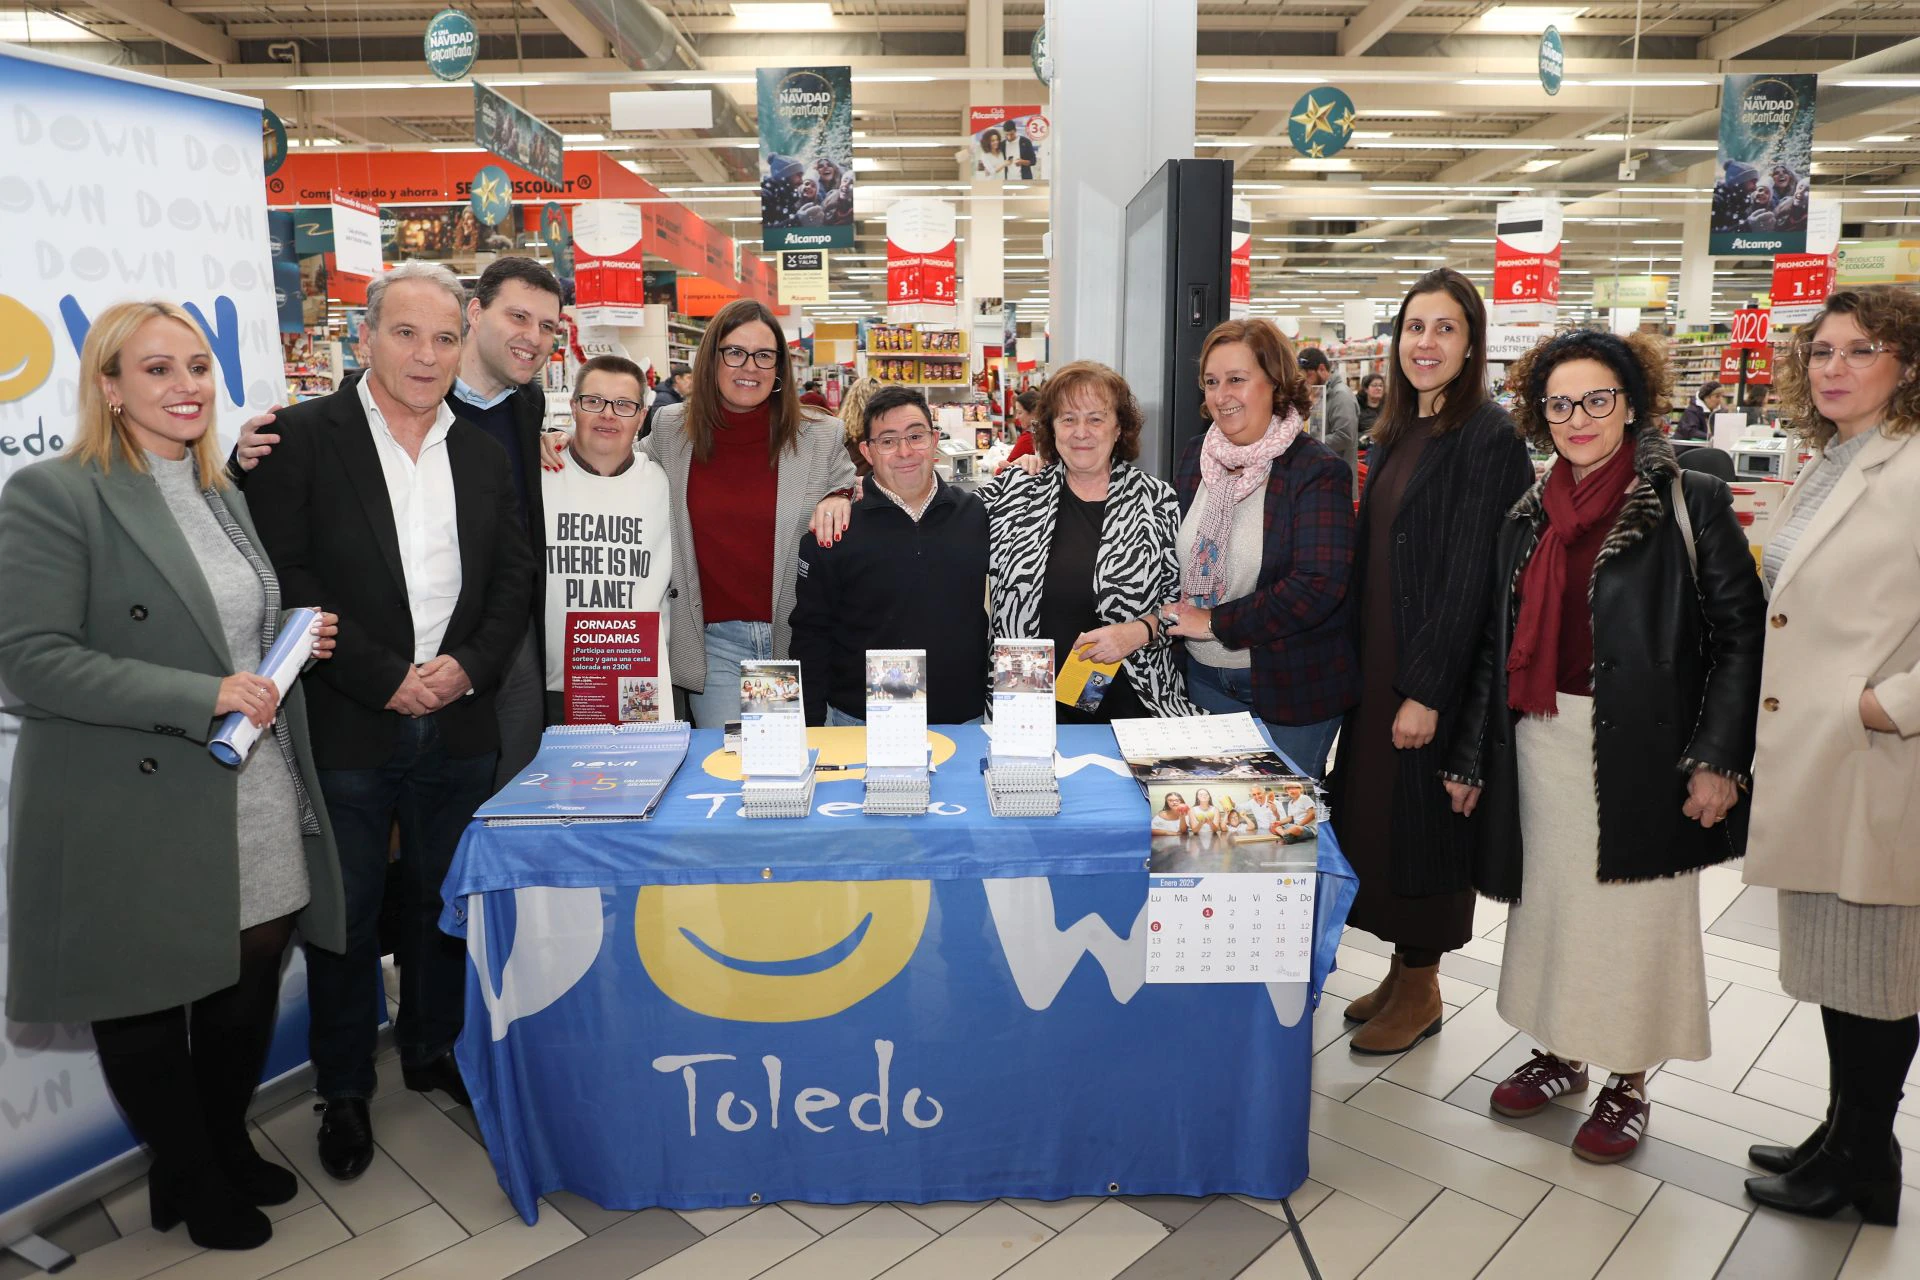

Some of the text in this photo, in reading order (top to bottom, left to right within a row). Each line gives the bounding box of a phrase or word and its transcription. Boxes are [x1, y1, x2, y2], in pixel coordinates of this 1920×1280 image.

[430, 32, 473, 48] NAVIDAD
[431, 45, 472, 62] encantada
[779, 92, 830, 103] NAVIDAD
[779, 103, 829, 118] encantada
[1743, 100, 1794, 111] NAVIDAD
[1742, 110, 1791, 124] encantada
[400, 187, 438, 196] ahorra
[784, 232, 832, 244] Alcampo
[1732, 238, 1782, 250] Alcampo
[602, 260, 641, 270] PROMOCIÓN
[1497, 257, 1540, 268] PROMOCIÓN
[1776, 259, 1824, 269] PROMOCIÓN
[1732, 313, 1769, 343] 2020
[1504, 335, 1536, 343] PASTEL
[557, 512, 643, 545] BECAUSE
[546, 545, 651, 579] THERE IS NO
[565, 578, 636, 610] PLANET
[573, 619, 637, 630] JORNADAS
[573, 633, 640, 644] SOLIDARIAS
[573, 647, 605, 655] ¡Participa
[1160, 879, 1195, 887] Enero 2025
[1151, 894, 1312, 903] Lu Ma Mi Ju Vi Sa Do
[651, 1039, 945, 1138] Toledo
